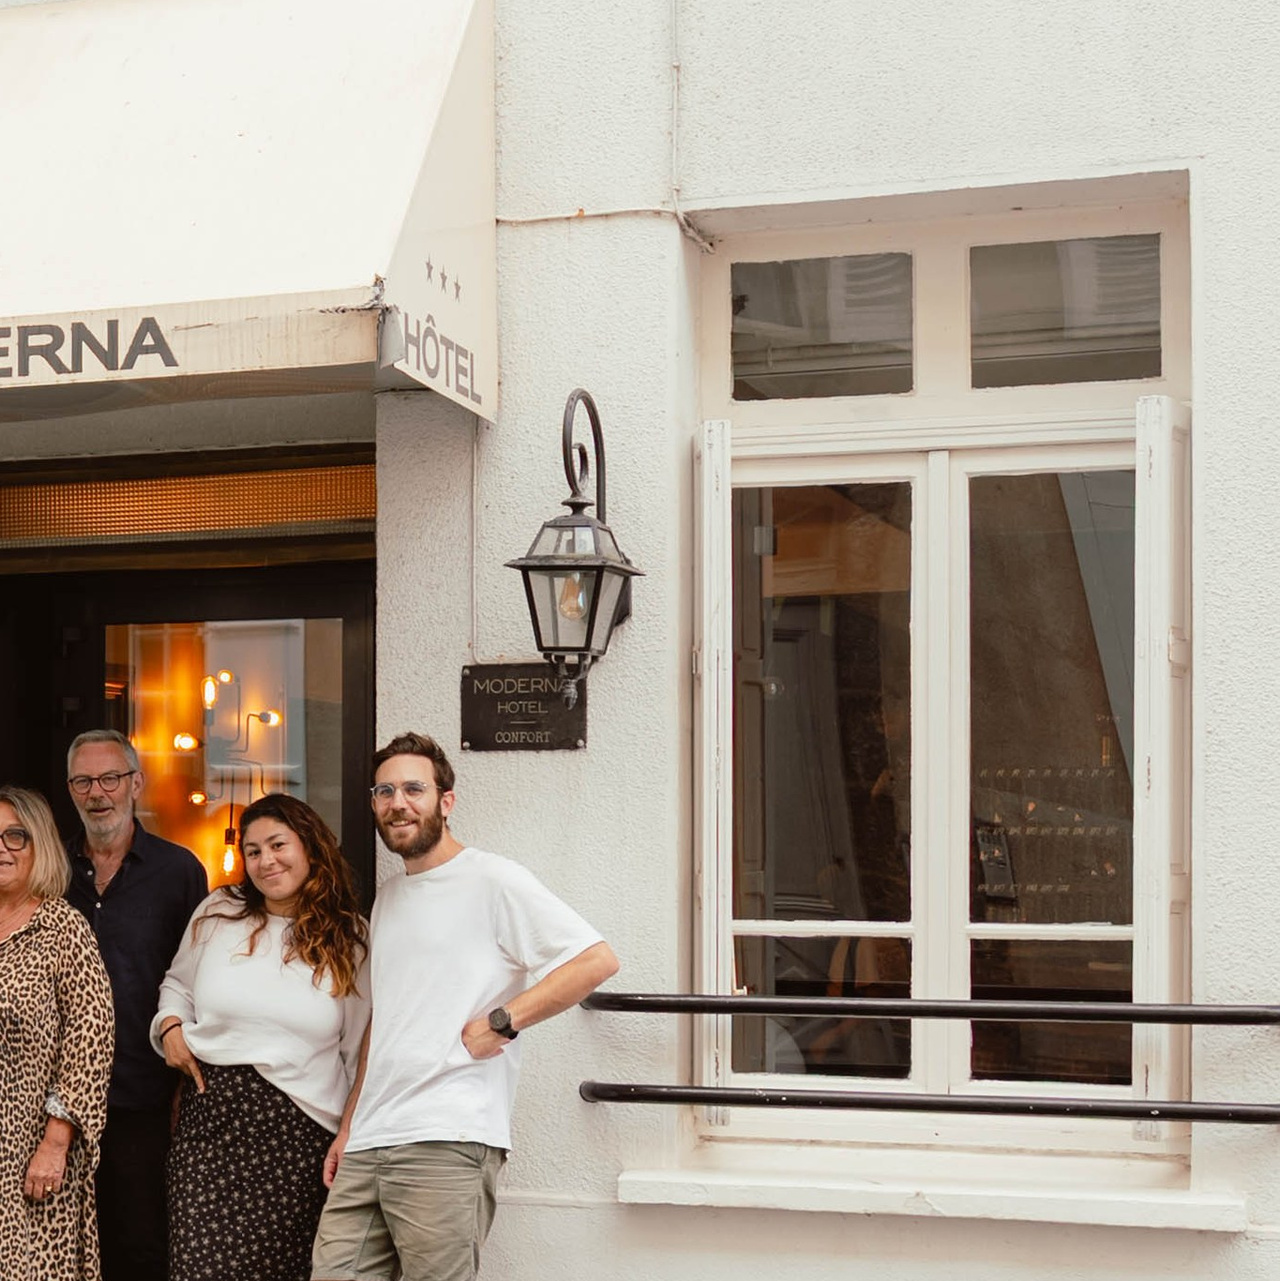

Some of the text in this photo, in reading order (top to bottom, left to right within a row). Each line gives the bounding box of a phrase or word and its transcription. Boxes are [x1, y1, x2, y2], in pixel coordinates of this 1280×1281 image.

[404, 312, 482, 404] HÔTEL
[497, 700, 548, 714] HOTEL
[495, 731, 551, 743] CONFORT
